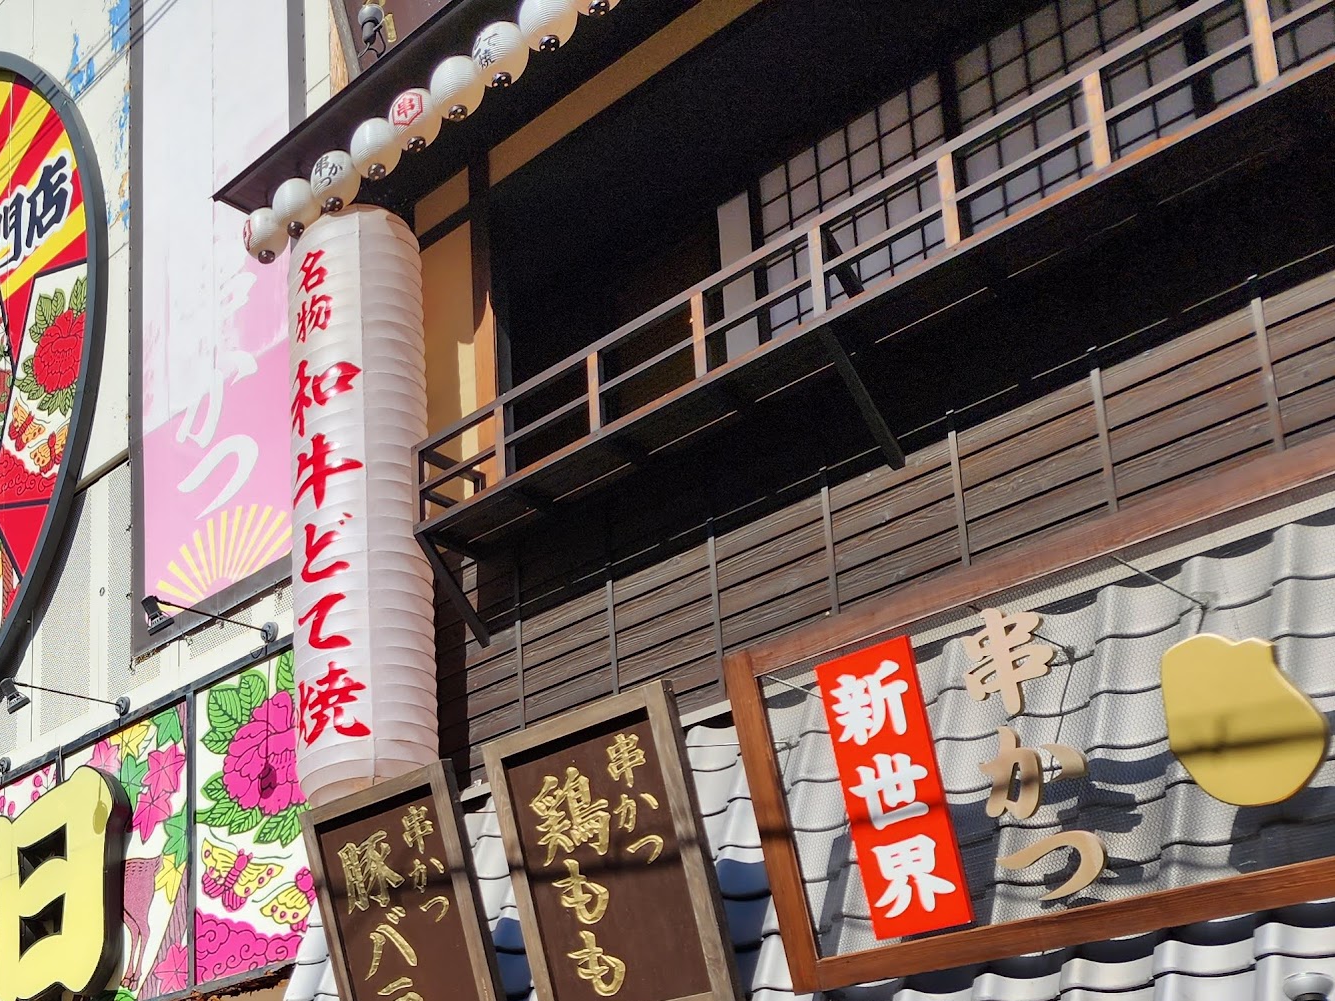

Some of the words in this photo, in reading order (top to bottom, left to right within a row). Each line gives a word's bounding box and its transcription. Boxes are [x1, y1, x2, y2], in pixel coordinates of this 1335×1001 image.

[315, 156, 342, 186] 串かつ
[296, 249, 334, 344] 名物
[291, 360, 372, 751] 和牛どて焼
[606, 732, 665, 865] 串かつ
[831, 658, 957, 919] 新世界
[962, 608, 1109, 902] 串かつ
[401, 805, 450, 922] 串かつ
[529, 766, 627, 997] 鶏もも
